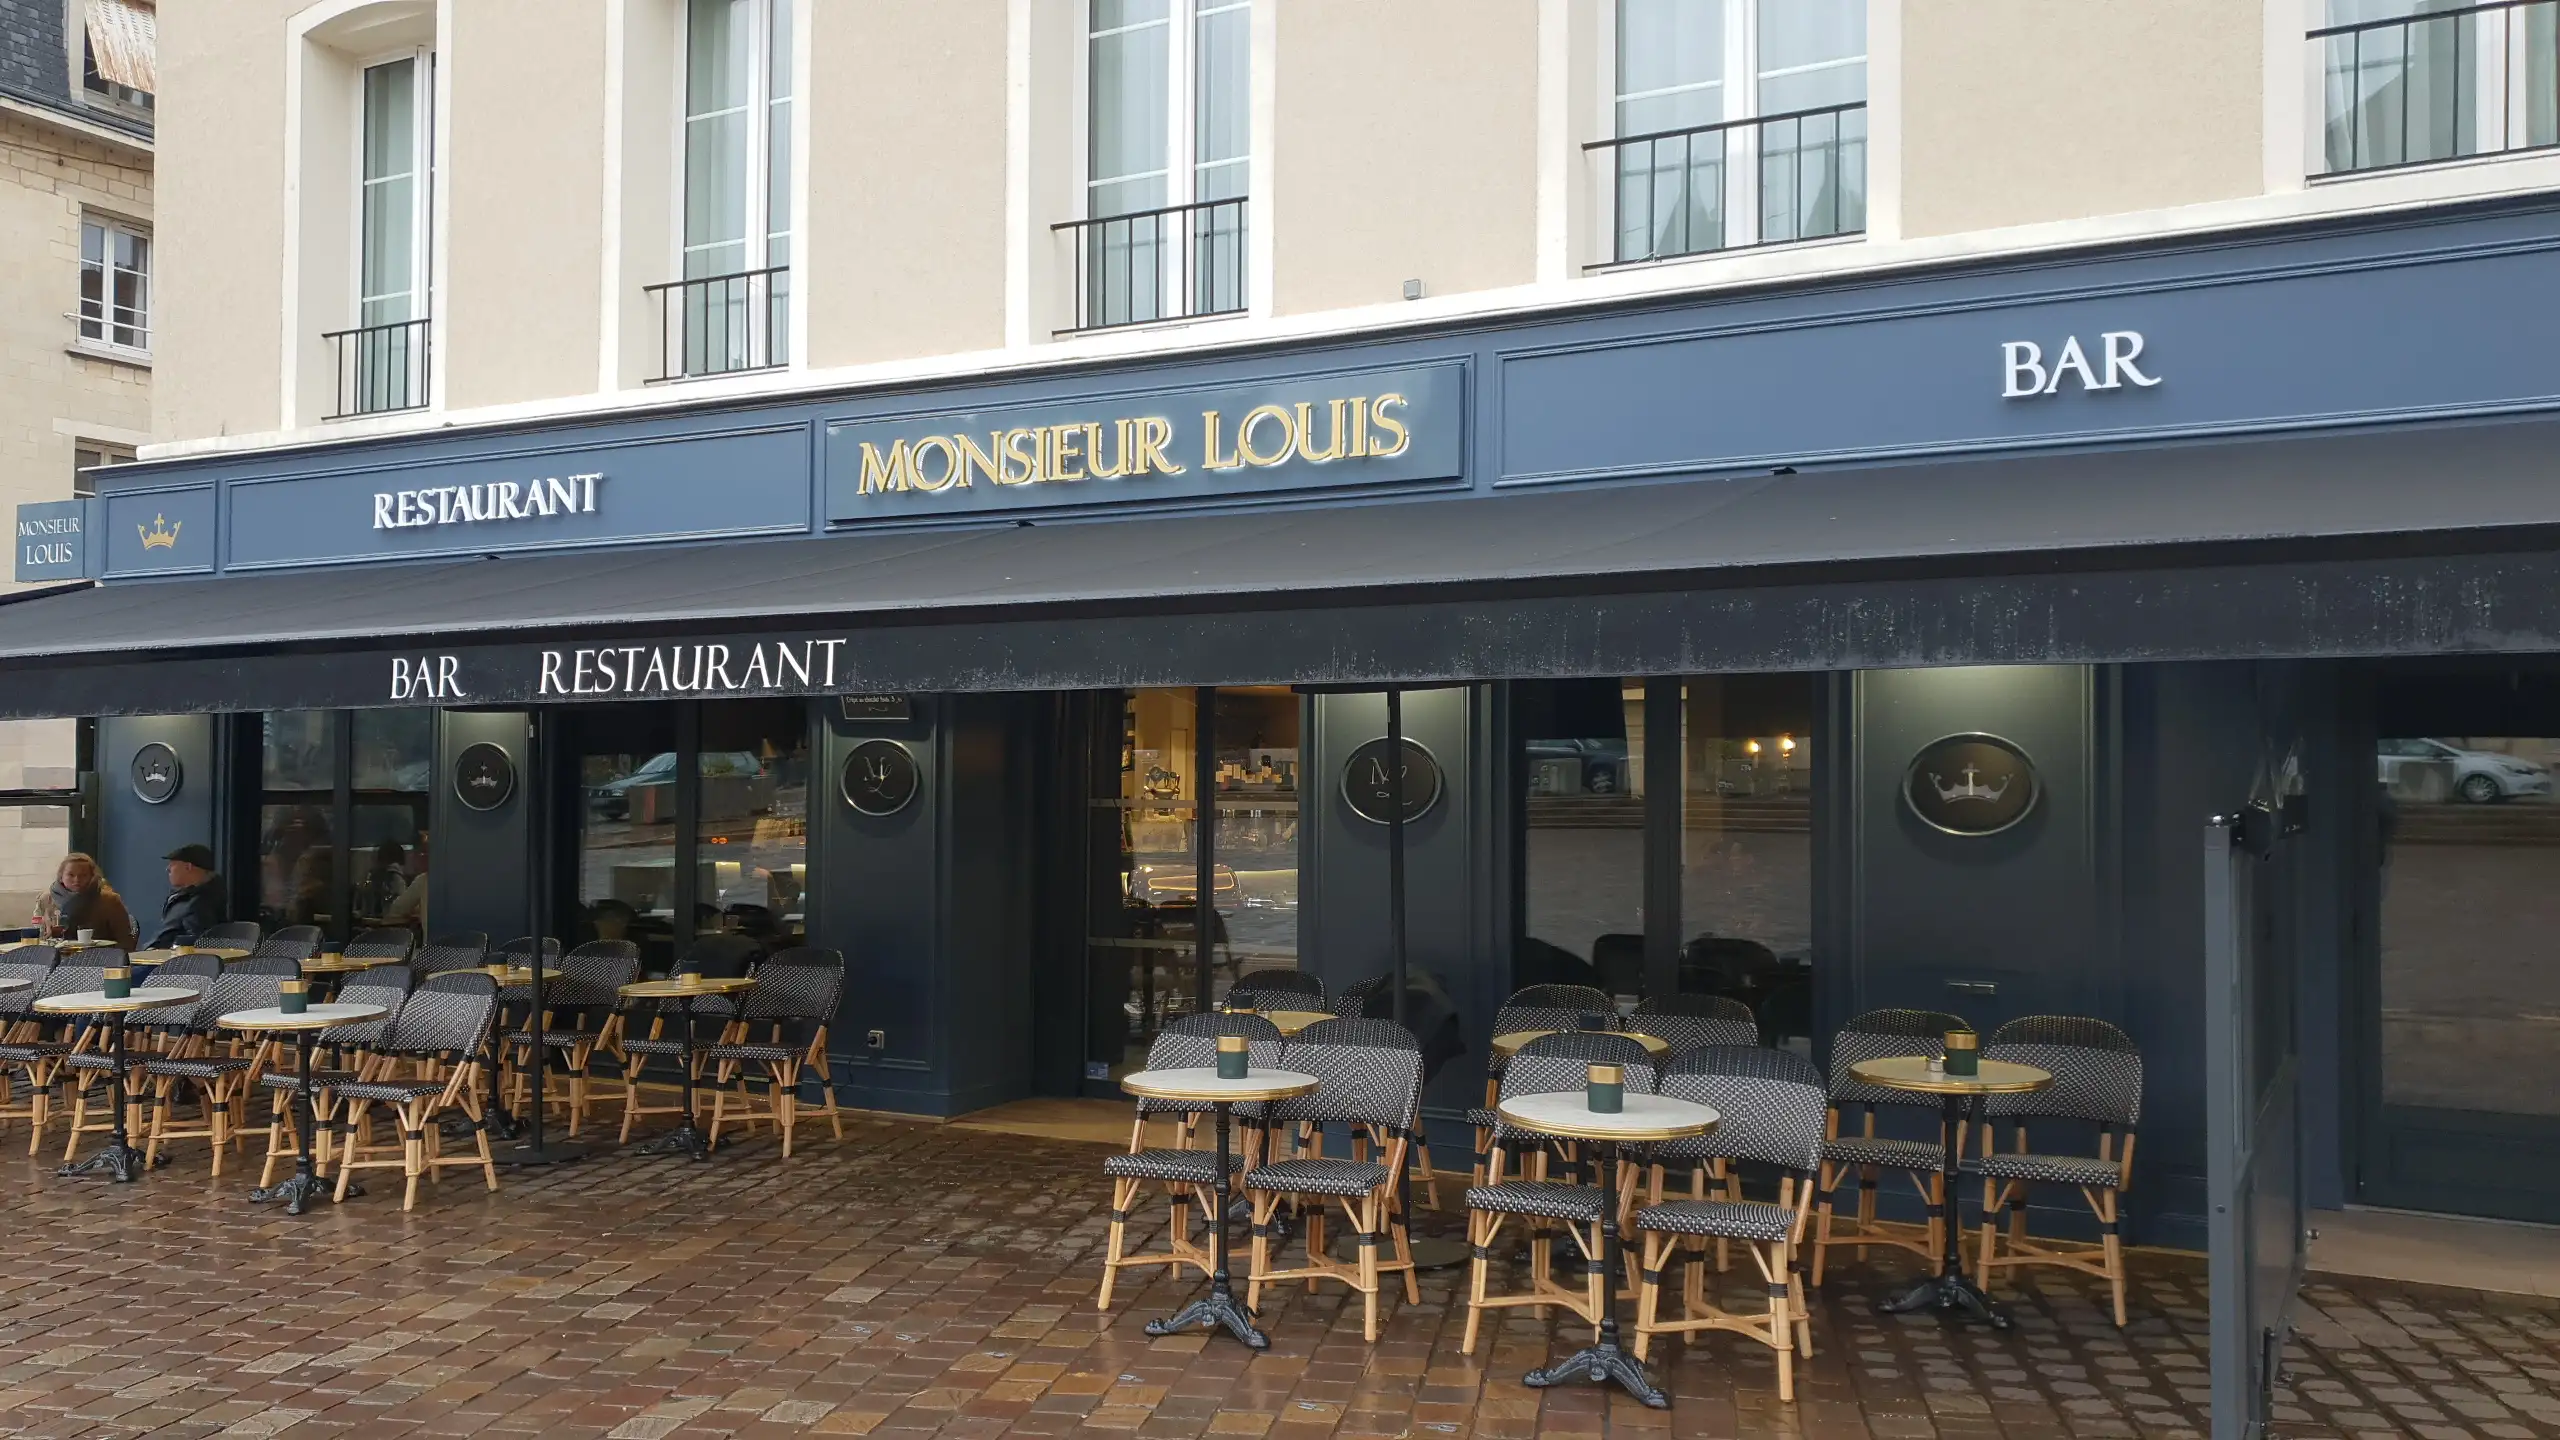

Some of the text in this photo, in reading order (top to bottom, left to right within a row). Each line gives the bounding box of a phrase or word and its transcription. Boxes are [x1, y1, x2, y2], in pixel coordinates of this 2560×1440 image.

[2001, 330, 2163, 398] BAR
[858, 392, 1413, 497] MONSIEUR LOUIS
[18, 517, 80, 537] MONSIEUR
[373, 472, 604, 531] RESTAURANT
[26, 541, 73, 566] LOUIS
[390, 637, 847, 700] BAR RESTAURANT
